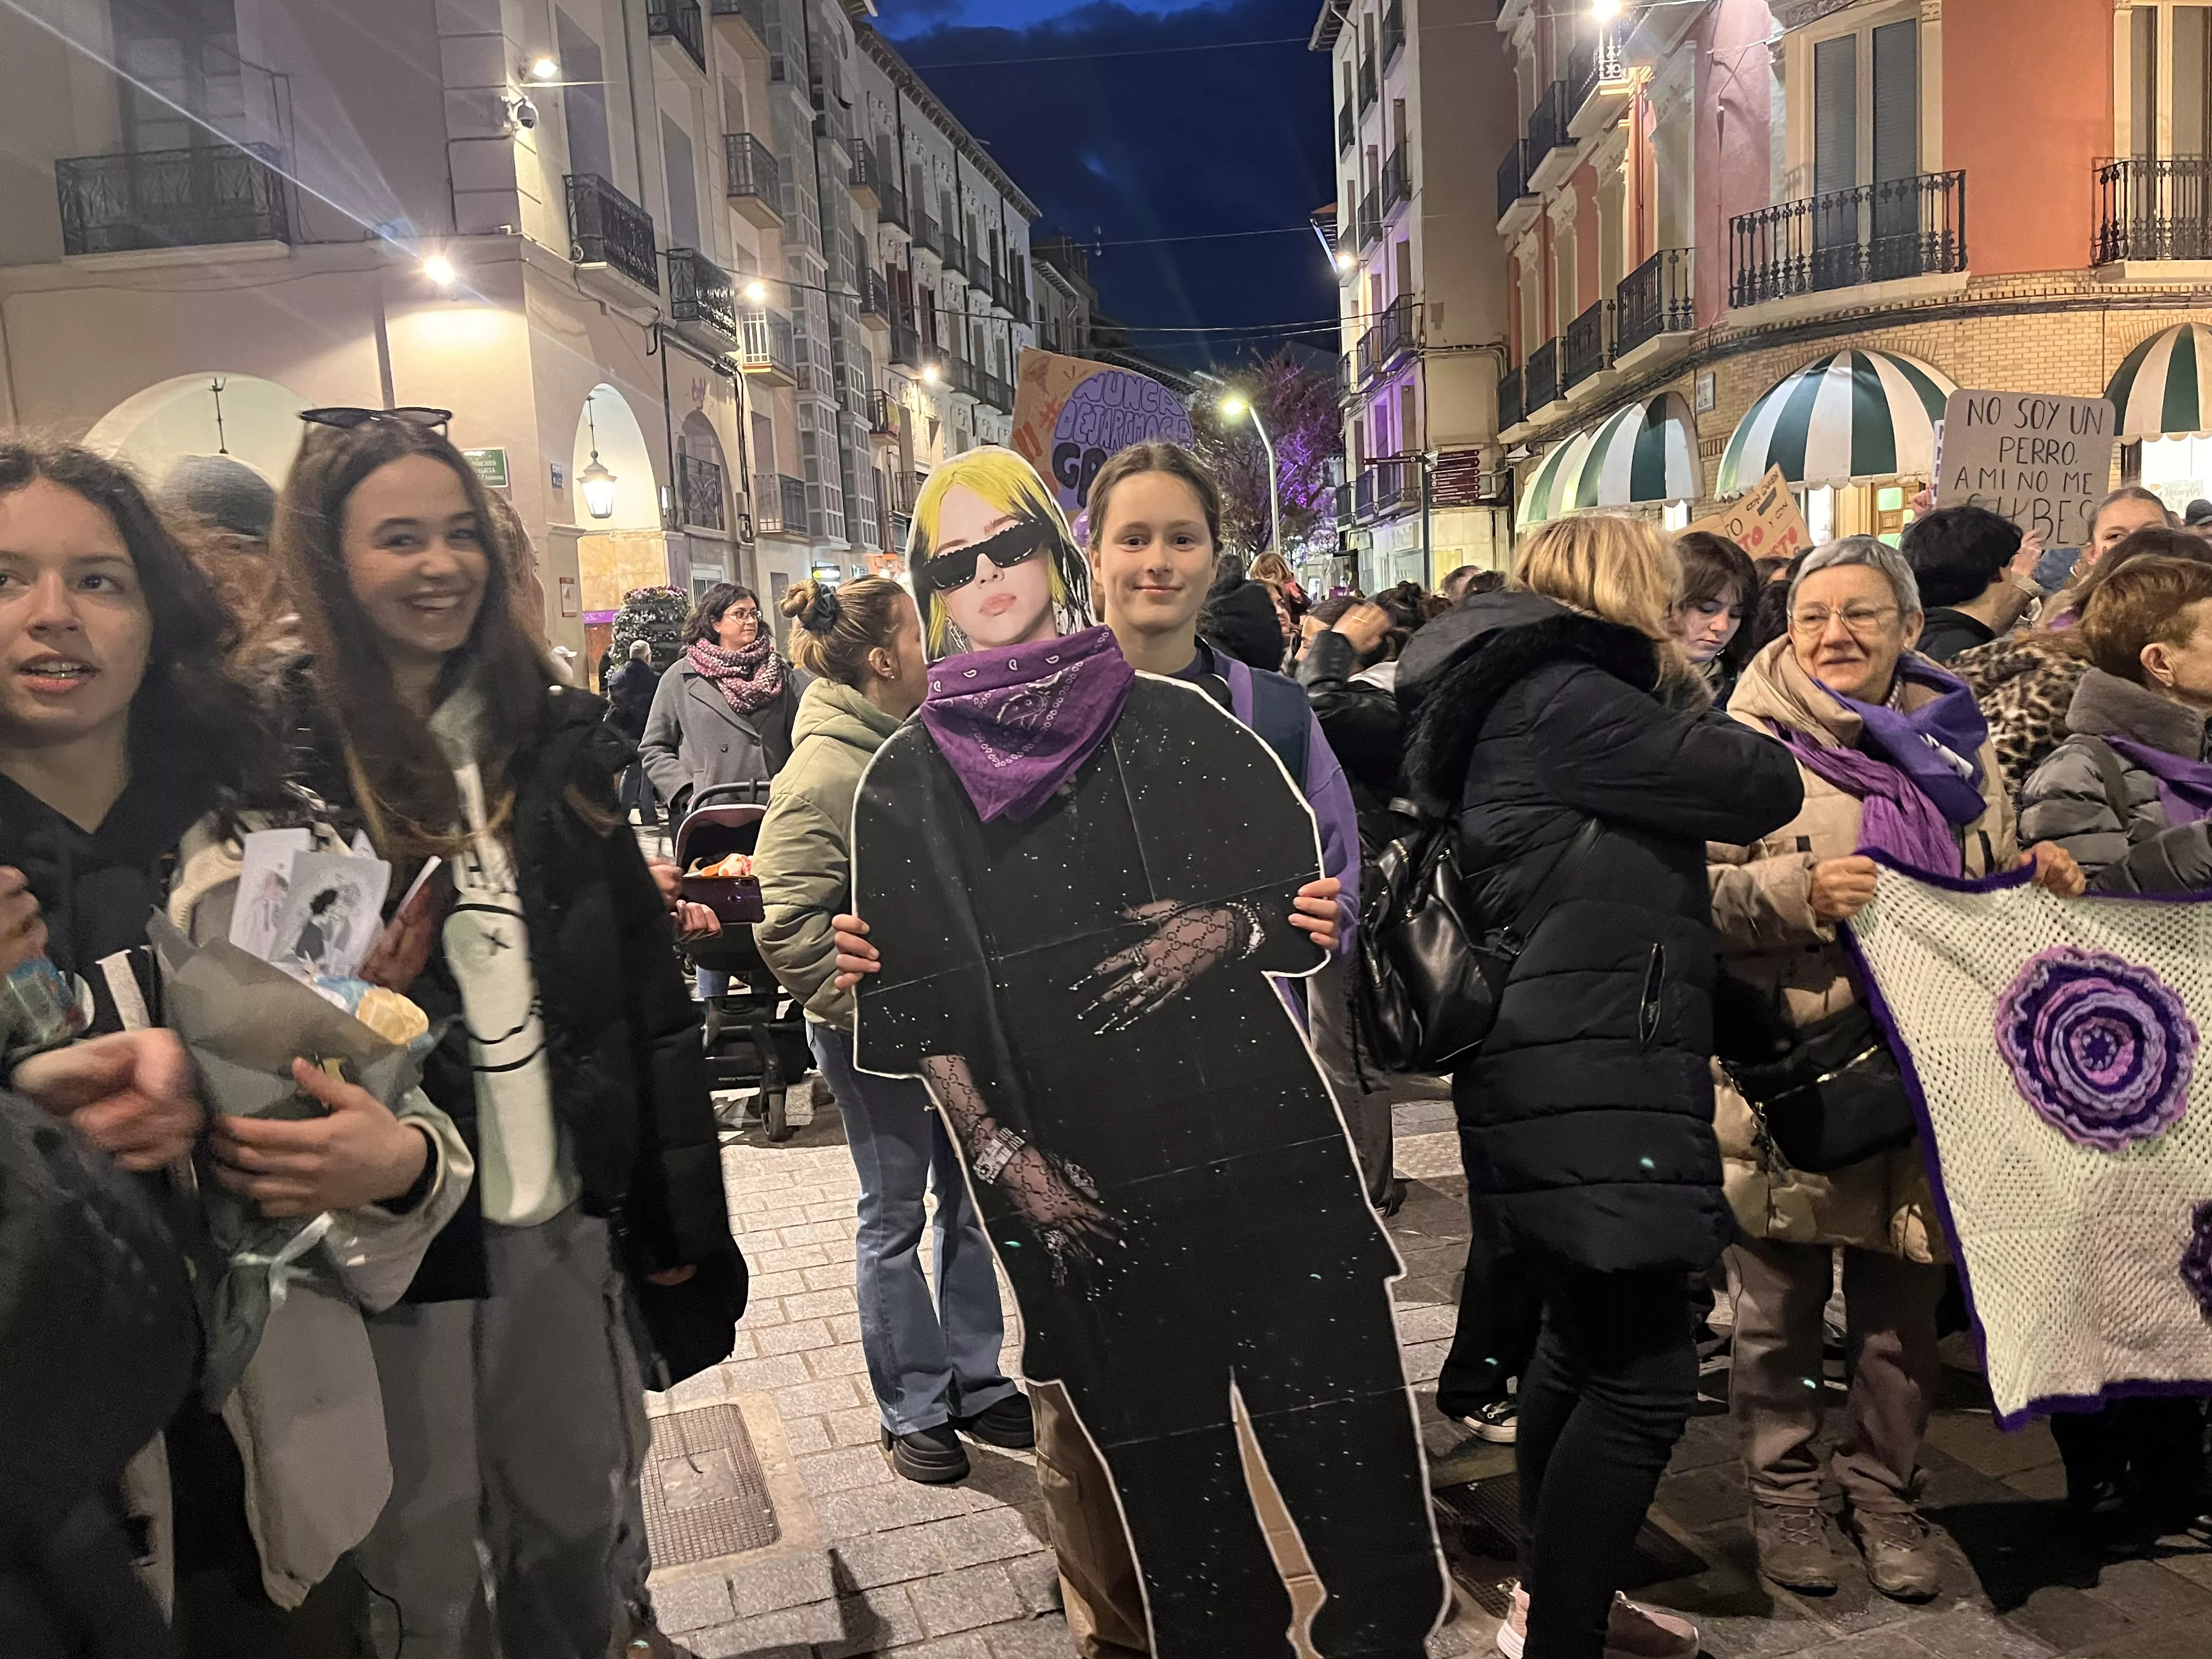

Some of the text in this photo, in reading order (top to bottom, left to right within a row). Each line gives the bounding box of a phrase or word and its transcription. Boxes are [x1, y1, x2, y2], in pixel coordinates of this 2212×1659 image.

[1073, 370, 1186, 416] NUNCA
[1967, 397, 2103, 435] NO SOY UN
[1954, 466, 2093, 495] A MI NO ME
